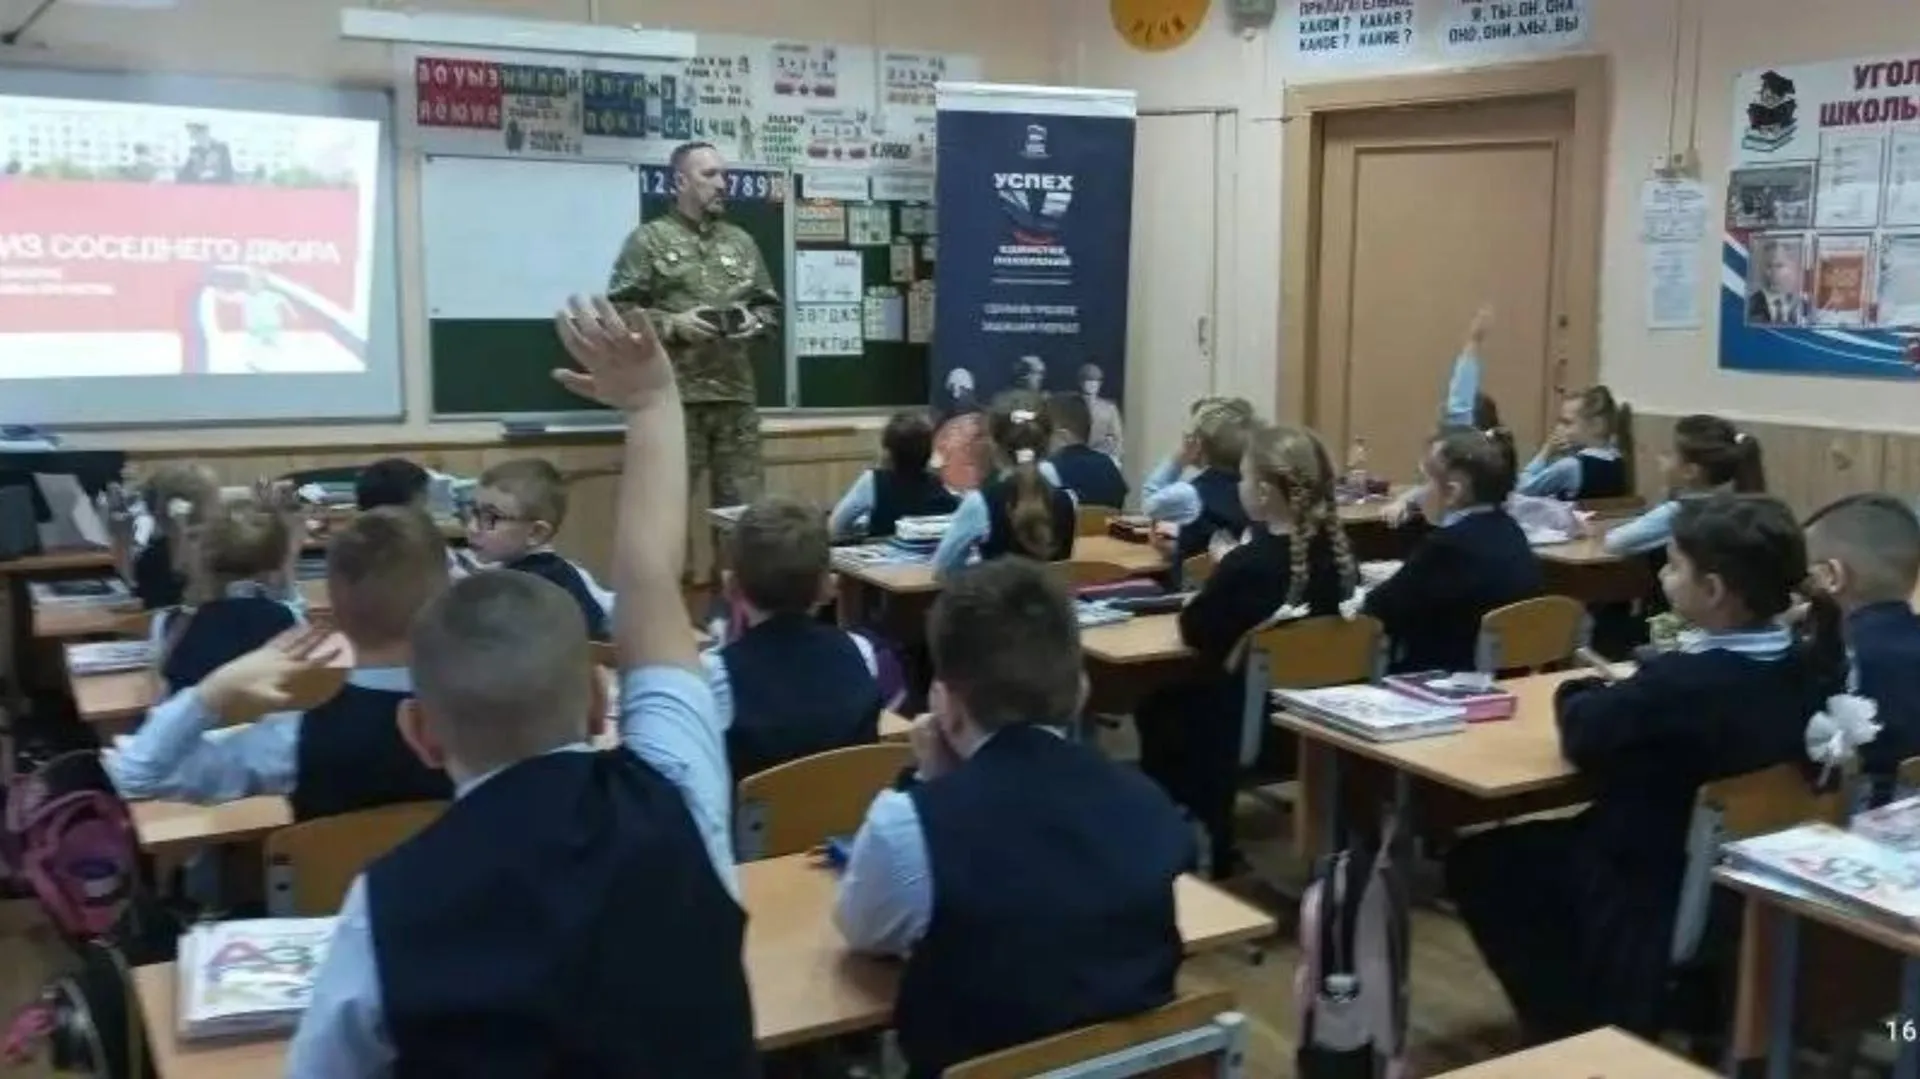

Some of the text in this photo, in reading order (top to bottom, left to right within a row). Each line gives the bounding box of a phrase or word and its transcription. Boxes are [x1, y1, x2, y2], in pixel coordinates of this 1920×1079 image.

[1854, 58, 1920, 91] УГОЛ
[993, 172, 1073, 191] УСПЕХ
[51, 234, 239, 264] СОСЕДНЕГО
[246, 237, 342, 267] ДВОРА
